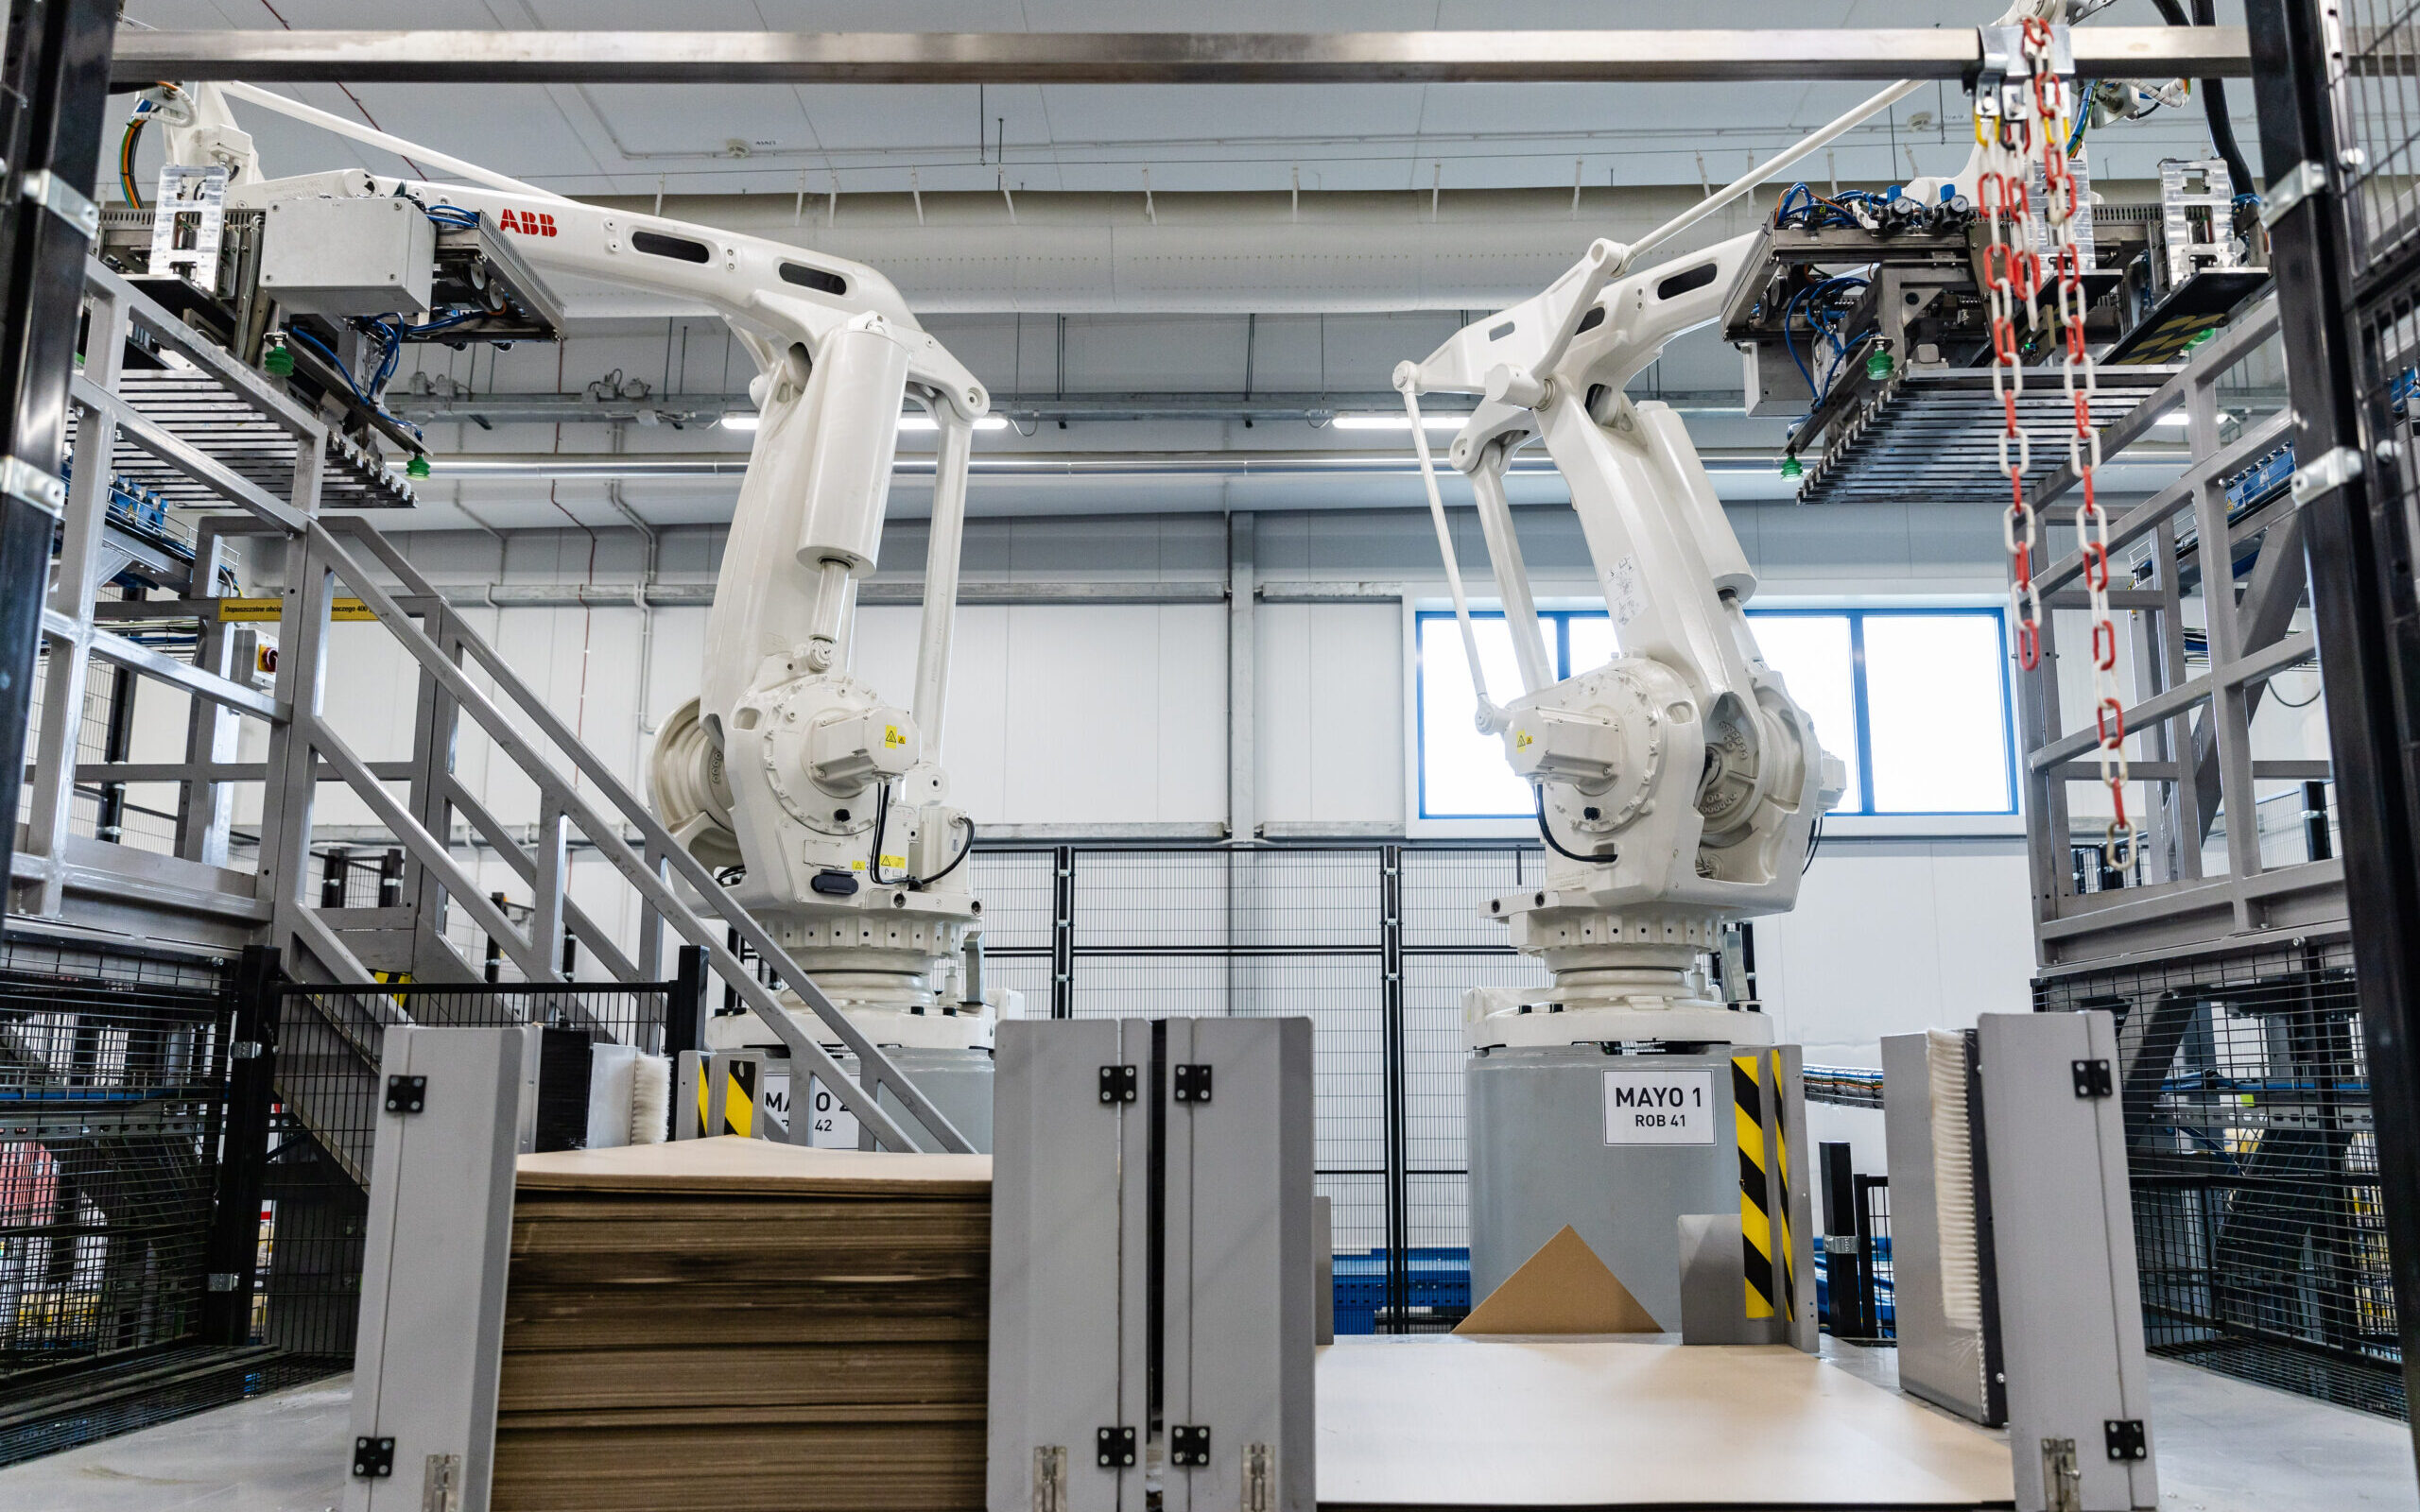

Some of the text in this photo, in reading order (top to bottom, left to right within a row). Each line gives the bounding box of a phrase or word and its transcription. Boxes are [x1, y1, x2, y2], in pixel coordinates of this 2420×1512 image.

[499, 208, 558, 237] ABB
[765, 1091, 831, 1112] MO
[1616, 1087, 1702, 1108] MAYO 1
[814, 1119, 833, 1132] 42
[1635, 1114, 1685, 1127] ROB 41
